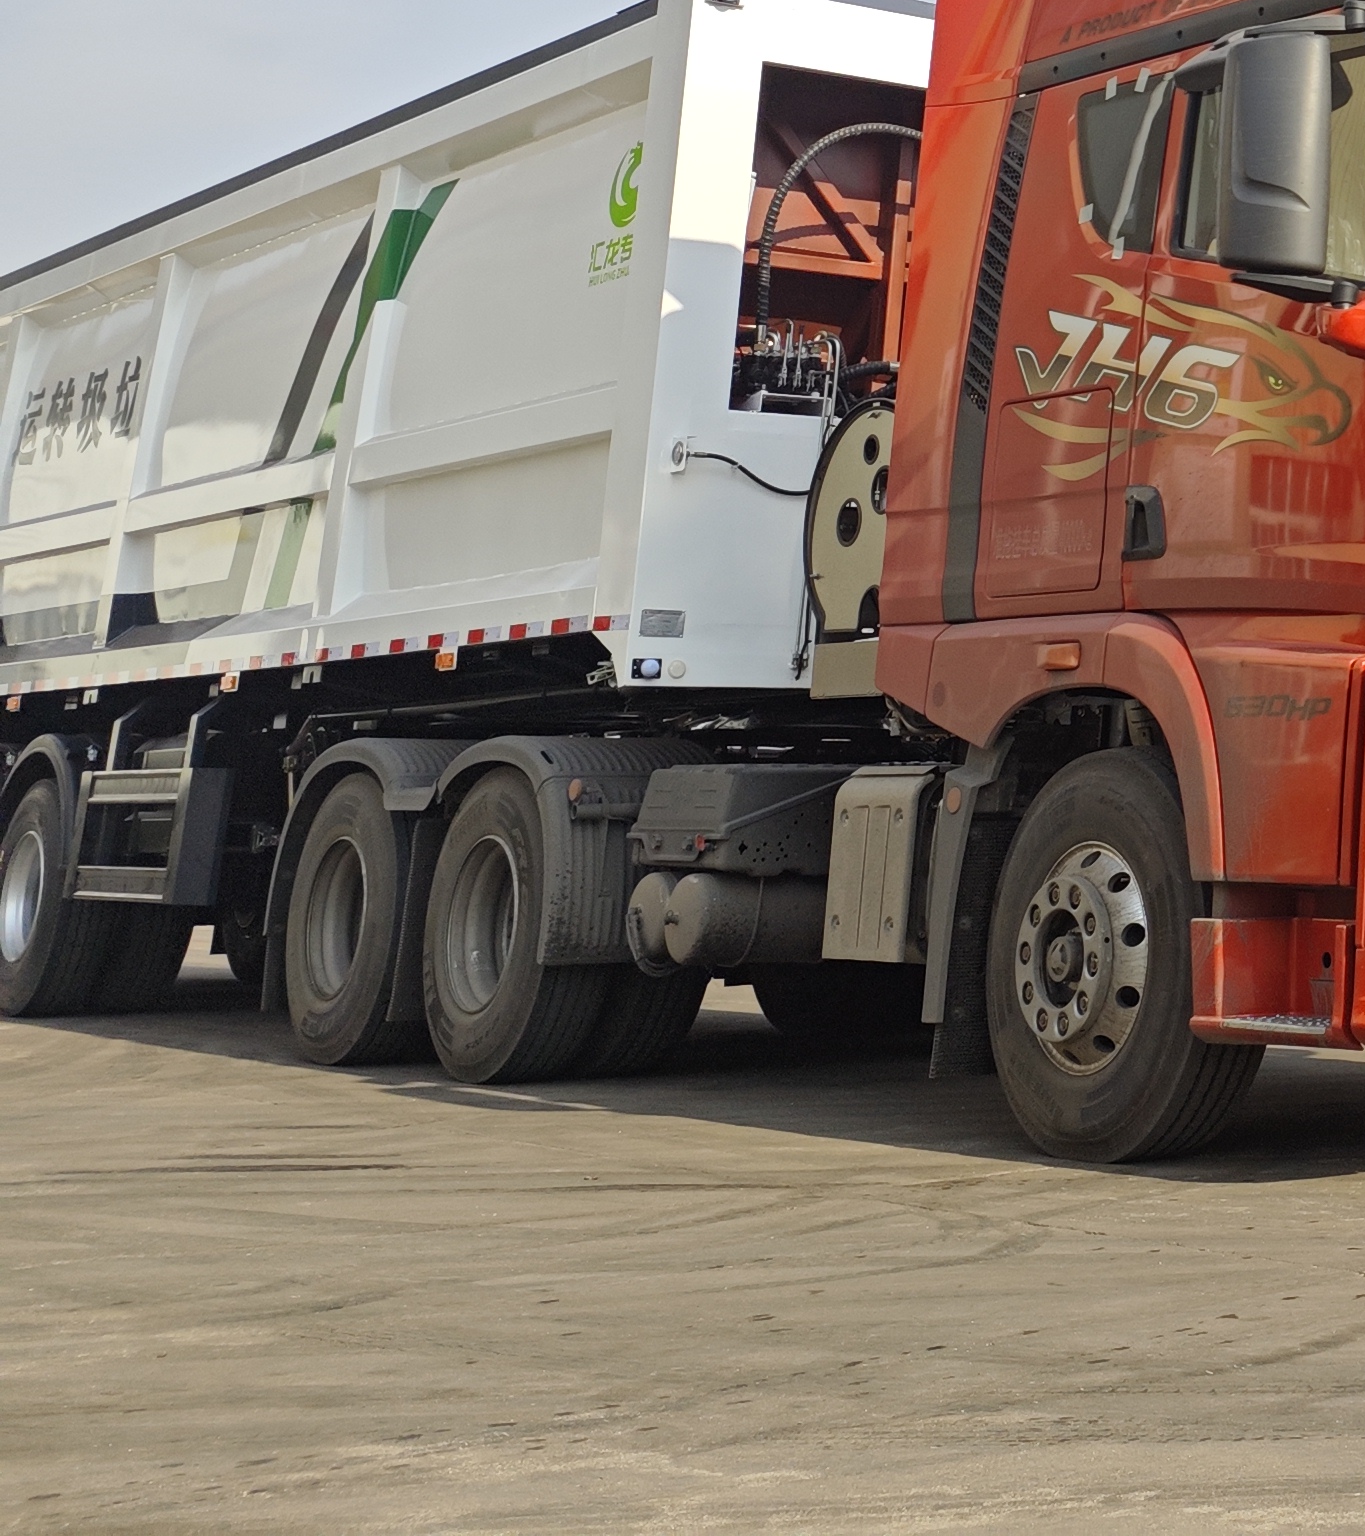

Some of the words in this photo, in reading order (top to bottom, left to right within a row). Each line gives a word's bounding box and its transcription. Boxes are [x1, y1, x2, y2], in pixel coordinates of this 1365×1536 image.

[1059, 26, 1073, 45] A
[1078, 0, 1157, 40] PRODUCT
[1015, 310, 1242, 429] JH6
[1223, 694, 1332, 722] 630HP
